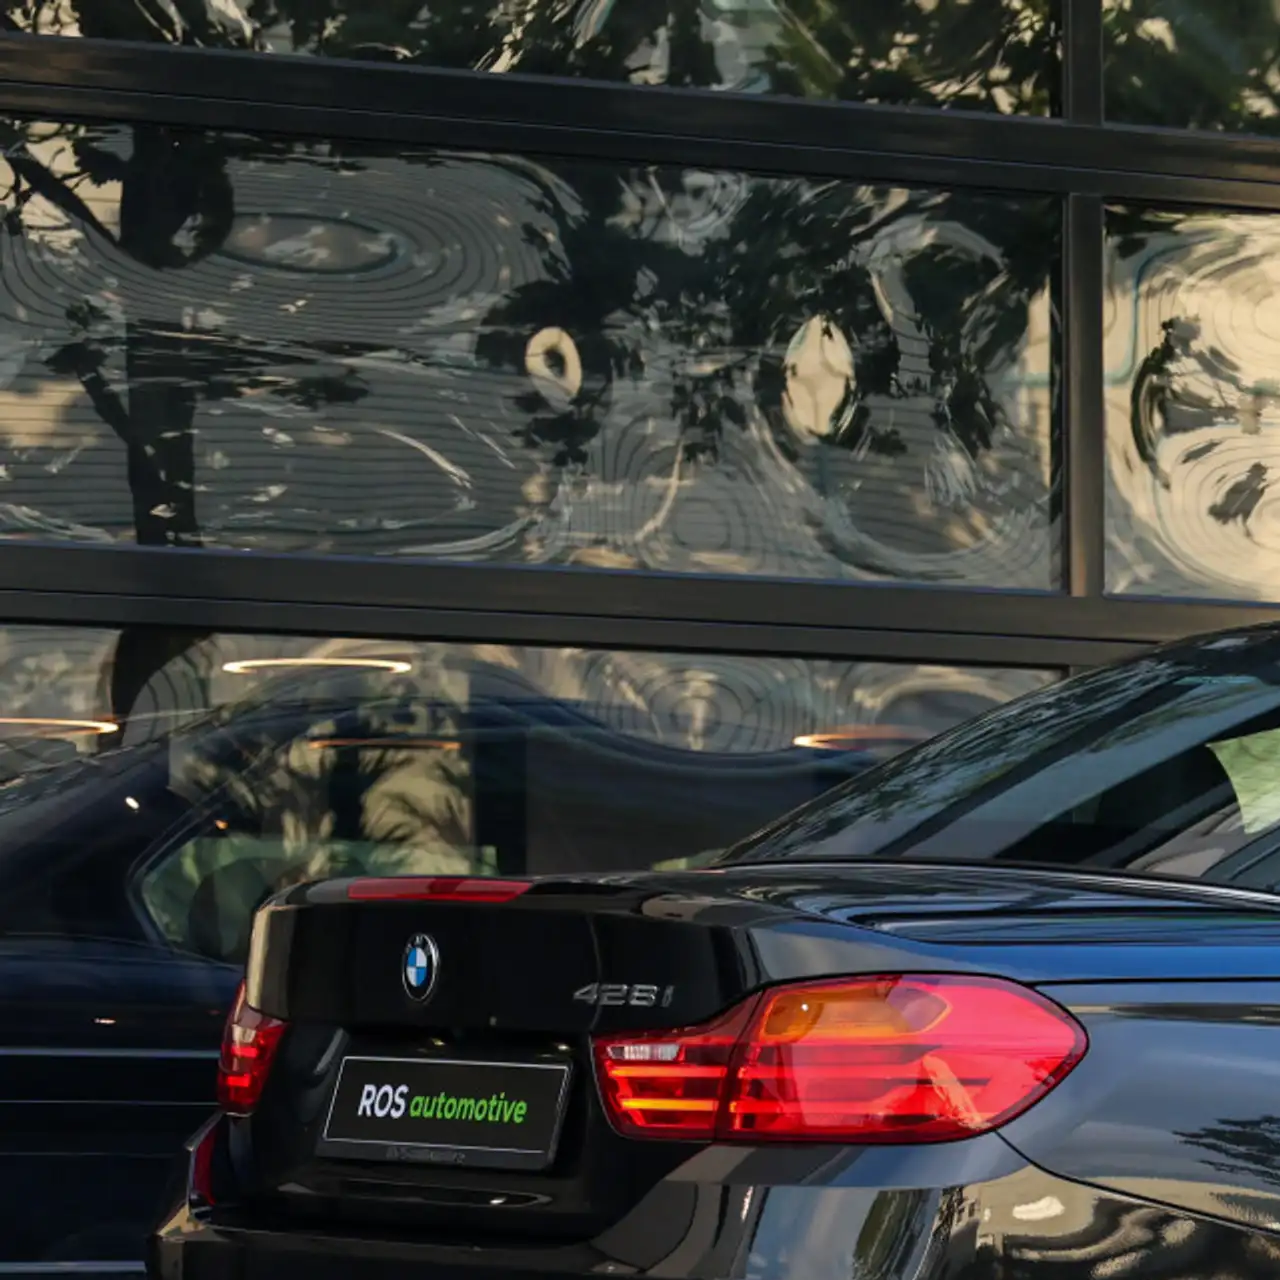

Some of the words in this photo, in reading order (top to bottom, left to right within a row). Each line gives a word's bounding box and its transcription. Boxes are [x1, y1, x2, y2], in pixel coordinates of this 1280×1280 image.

[573, 982, 674, 1007] 428i
[357, 1083, 409, 1119] ROS
[409, 1092, 528, 1124] automotive
